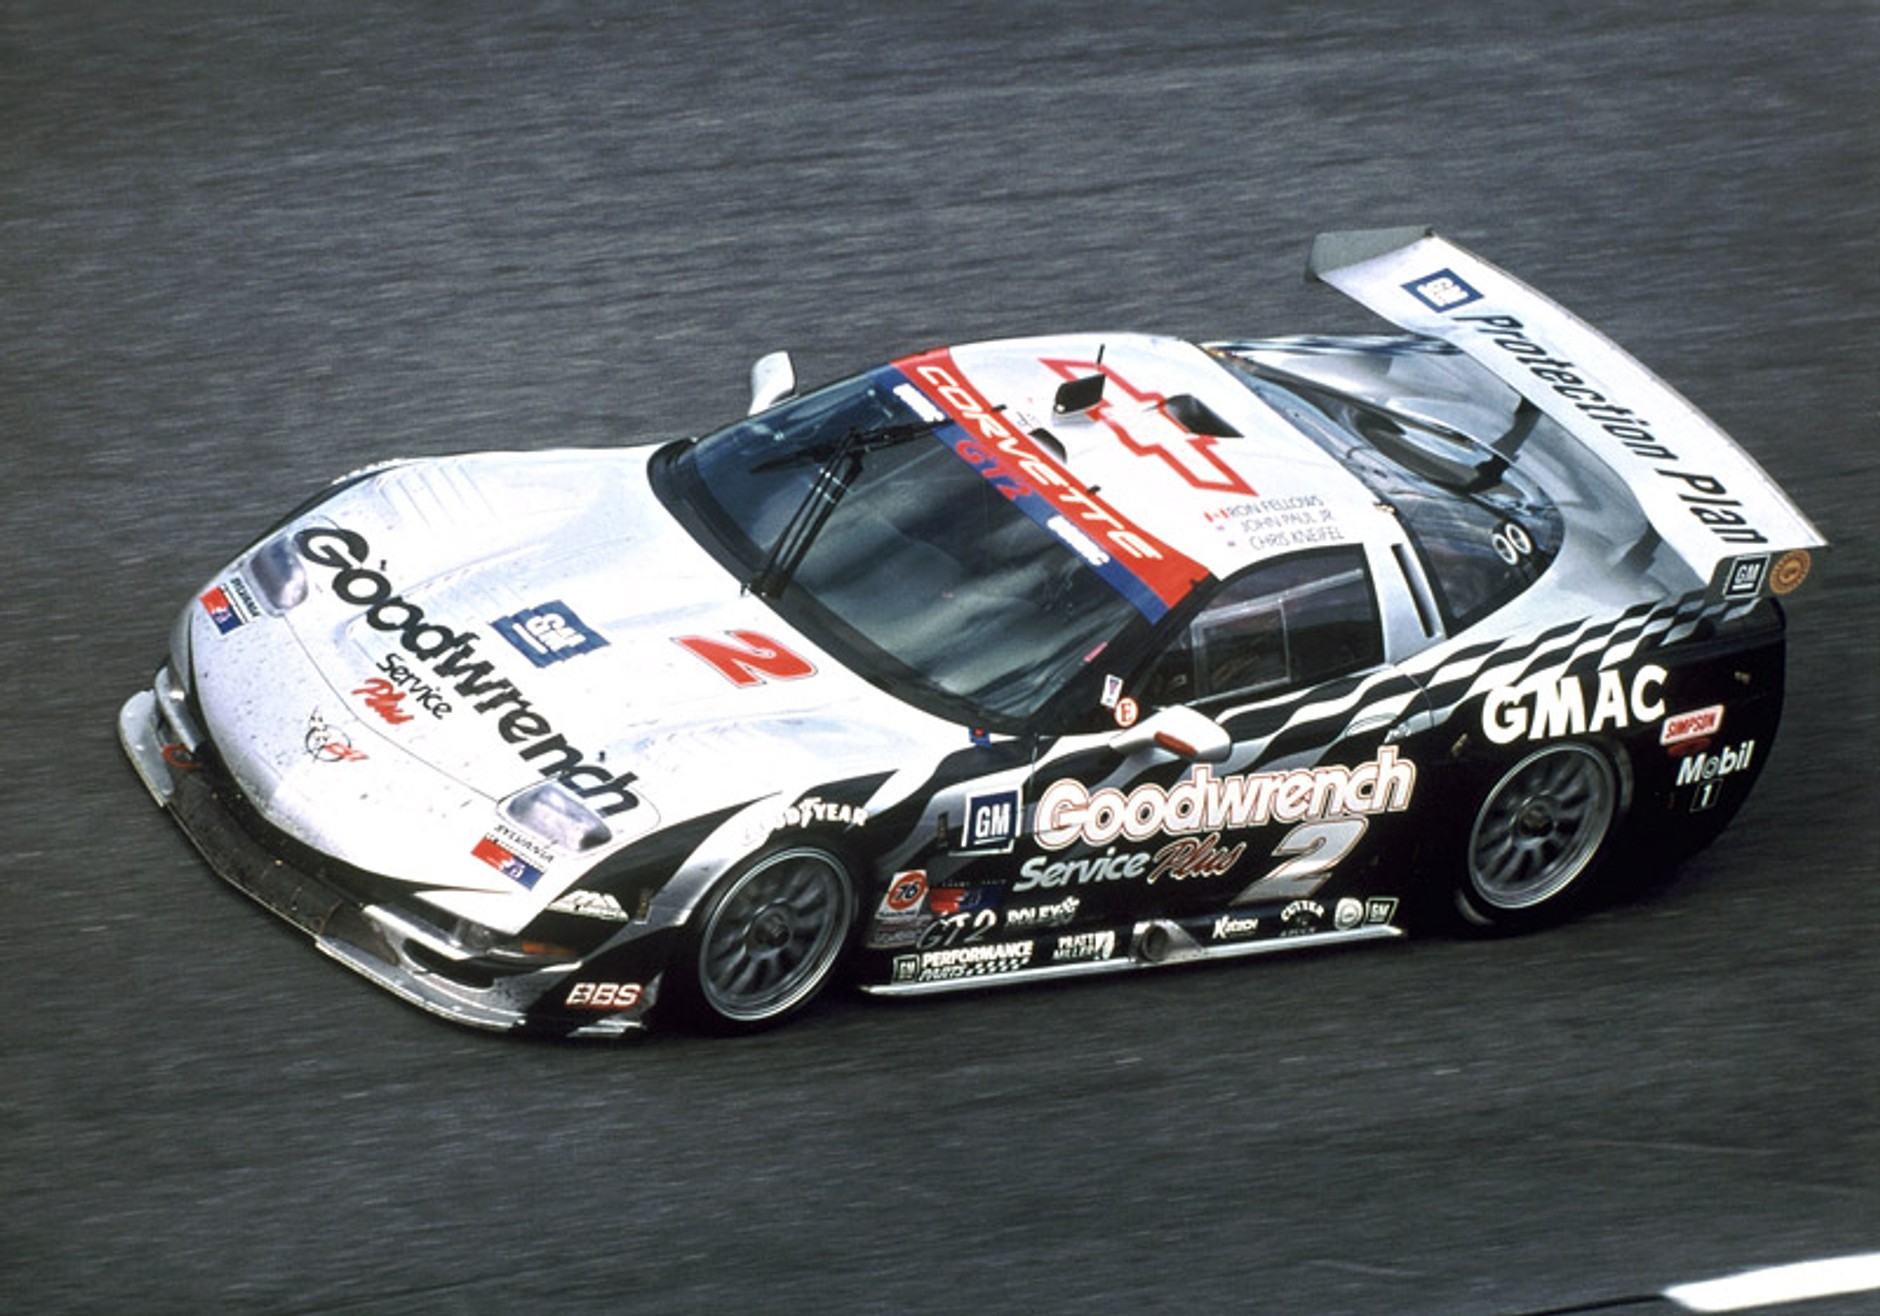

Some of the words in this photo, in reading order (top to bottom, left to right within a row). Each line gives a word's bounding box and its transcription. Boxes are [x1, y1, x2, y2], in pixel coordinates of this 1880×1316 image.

[1454, 314, 1678, 461] Protection
[1655, 468, 1768, 544] Plan
[916, 365, 1163, 560] CORVETTE
[955, 439, 1034, 501] GT2
[1734, 564, 1761, 584] GM
[299, 527, 641, 818] Goodwrench
[376, 652, 453, 721] Service
[672, 629, 819, 688] 2
[351, 678, 415, 725] Plus
[1482, 665, 1669, 744] GMAC
[1665, 712, 1717, 739] SIMPSON
[1676, 739, 1755, 787] Mobil
[975, 802, 1012, 838] GM
[1033, 745, 1416, 849] Goodwrench
[1701, 784, 1713, 808] 1
[1012, 847, 1152, 893] Service
[1148, 832, 1246, 884] Plus
[1235, 815, 1368, 906] 2
[895, 884, 919, 903] 76
[920, 941, 1033, 968] PERFORMANCE
[566, 983, 642, 1006] BBS
